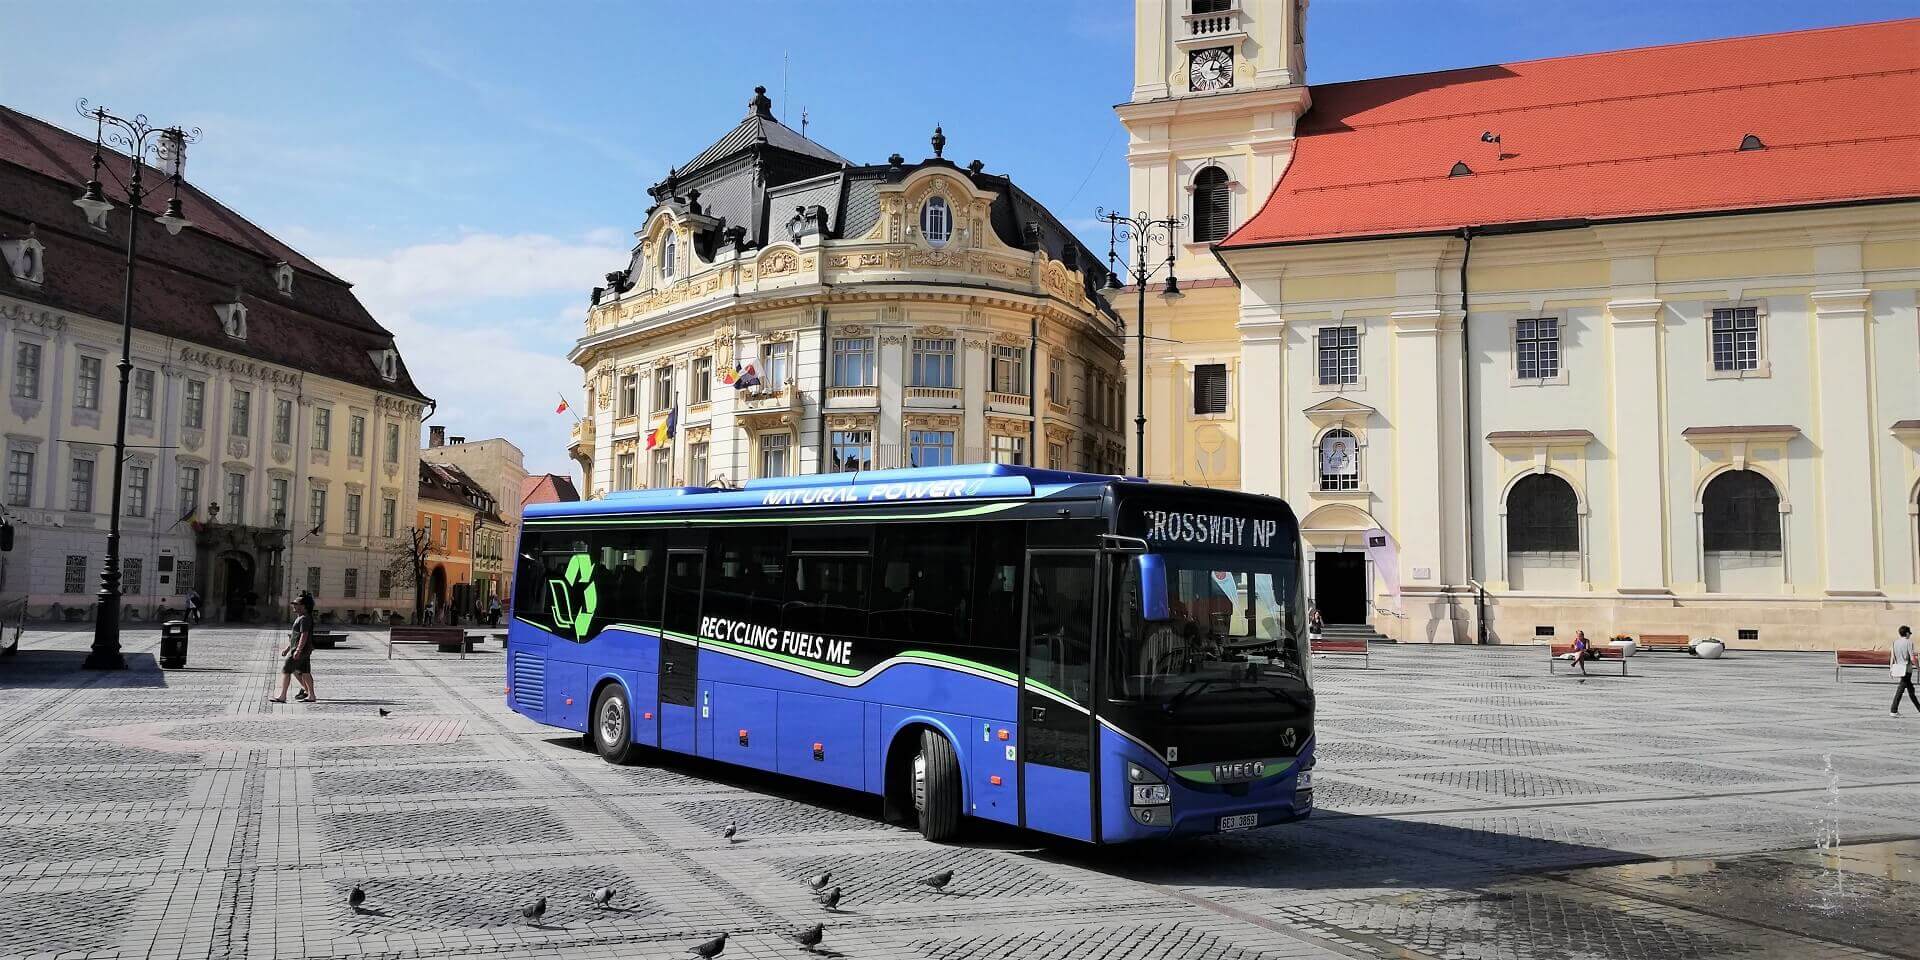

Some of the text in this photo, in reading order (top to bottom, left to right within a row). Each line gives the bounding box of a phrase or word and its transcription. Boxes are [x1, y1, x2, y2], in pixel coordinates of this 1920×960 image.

[762, 480, 967, 505] NATURAL POWER
[1253, 519, 1276, 548] NP
[700, 616, 853, 665] RECYCLING FUELS ME
[1215, 761, 1265, 782] IVECO
